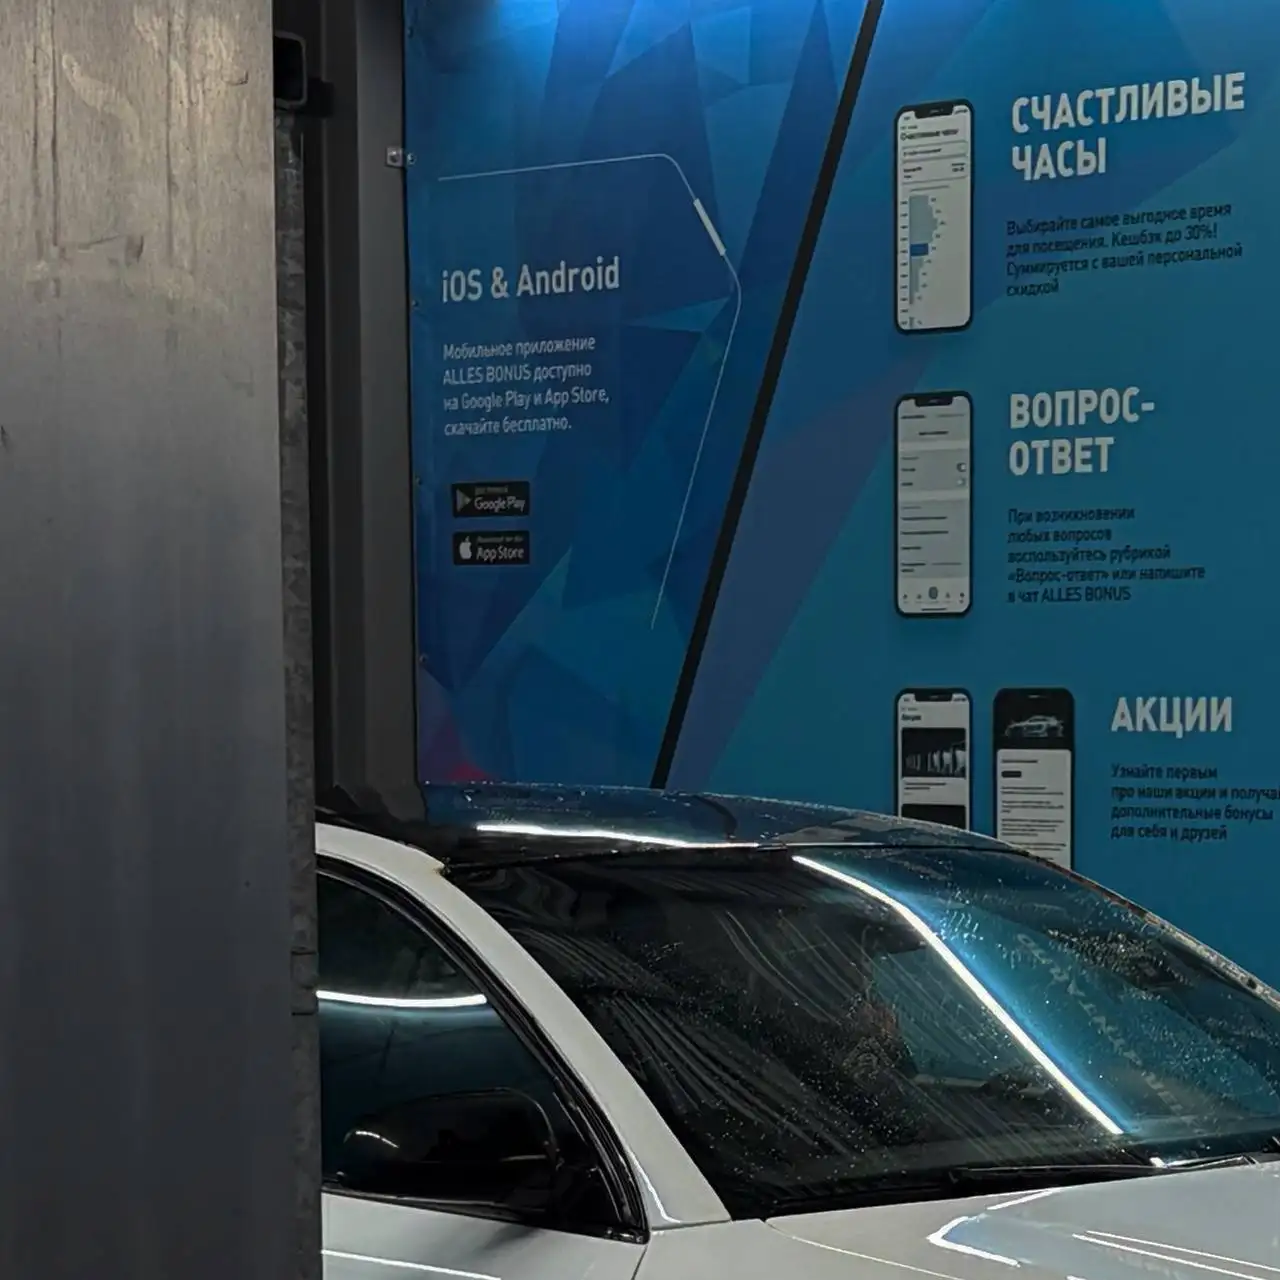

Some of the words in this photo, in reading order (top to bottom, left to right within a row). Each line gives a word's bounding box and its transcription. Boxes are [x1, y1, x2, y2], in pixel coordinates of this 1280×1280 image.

[1011, 72, 1245, 133] СЧАСТЛИВЫЕ
[1011, 137, 1106, 181] ЧАСЫ
[1006, 217, 1077, 237] Выбирайте
[1080, 213, 1119, 232] самое
[1122, 207, 1187, 228] выгодное
[1190, 203, 1231, 225] время
[1007, 241, 1030, 258] для
[1032, 236, 1108, 254] посещения.
[1165, 229, 1182, 245] до
[1184, 223, 1218, 241] 30%!
[1007, 260, 1089, 278] Суммируется
[1092, 258, 1099, 270] с
[1102, 251, 1145, 270] вашей
[1147, 244, 1243, 268] персональной
[442, 269, 482, 303] iOS
[490, 267, 509, 298] &
[516, 256, 621, 297] Android
[1007, 278, 1060, 297] скидкой
[443, 342, 512, 361] Мобильное
[515, 337, 596, 357] приложение
[443, 368, 484, 386] ALLES
[485, 365, 531, 384] BONUS
[533, 364, 592, 384] доступно
[443, 396, 459, 412] на
[461, 392, 502, 411] Google
[505, 390, 531, 411] Play
[533, 394, 543, 406] и
[544, 389, 569, 408] App
[571, 387, 610, 405] Store,
[1009, 386, 1156, 429] ВОПРОС-
[444, 417, 500, 437] скачайте
[502, 416, 572, 435] бесплатно.
[1009, 437, 1115, 476] ОТВЕТ
[474, 496, 505, 513] Google
[506, 495, 526, 513] Play
[1008, 509, 1034, 526] При
[1035, 506, 1136, 522] возникновении
[1008, 528, 1051, 544] любых
[1053, 527, 1113, 544] вопросов
[476, 546, 497, 563] App
[497, 544, 524, 560] Store
[1008, 547, 1107, 565] воспользуйтесь
[1110, 544, 1170, 562] рубрикой
[1112, 568, 1136, 581] или
[1139, 564, 1205, 580] напишите
[1018, 588, 1039, 602] чат
[1041, 587, 1082, 602] ALLES
[1085, 585, 1131, 602] BONUS
[1110, 696, 1233, 739] АКЦИИ
[1111, 763, 1163, 781] Узнайте
[1166, 766, 1217, 781] первым
[1111, 786, 1135, 801] про
[1138, 786, 1172, 799] наши
[1175, 786, 1216, 801] акции
[1219, 787, 1228, 799] и
[1111, 804, 1222, 821] дополнительные
[1224, 804, 1274, 821] бонусы
[1110, 825, 1135, 841] для
[1137, 824, 1168, 838] себя
[1170, 827, 1178, 839] и
[1181, 824, 1227, 843] друзей
